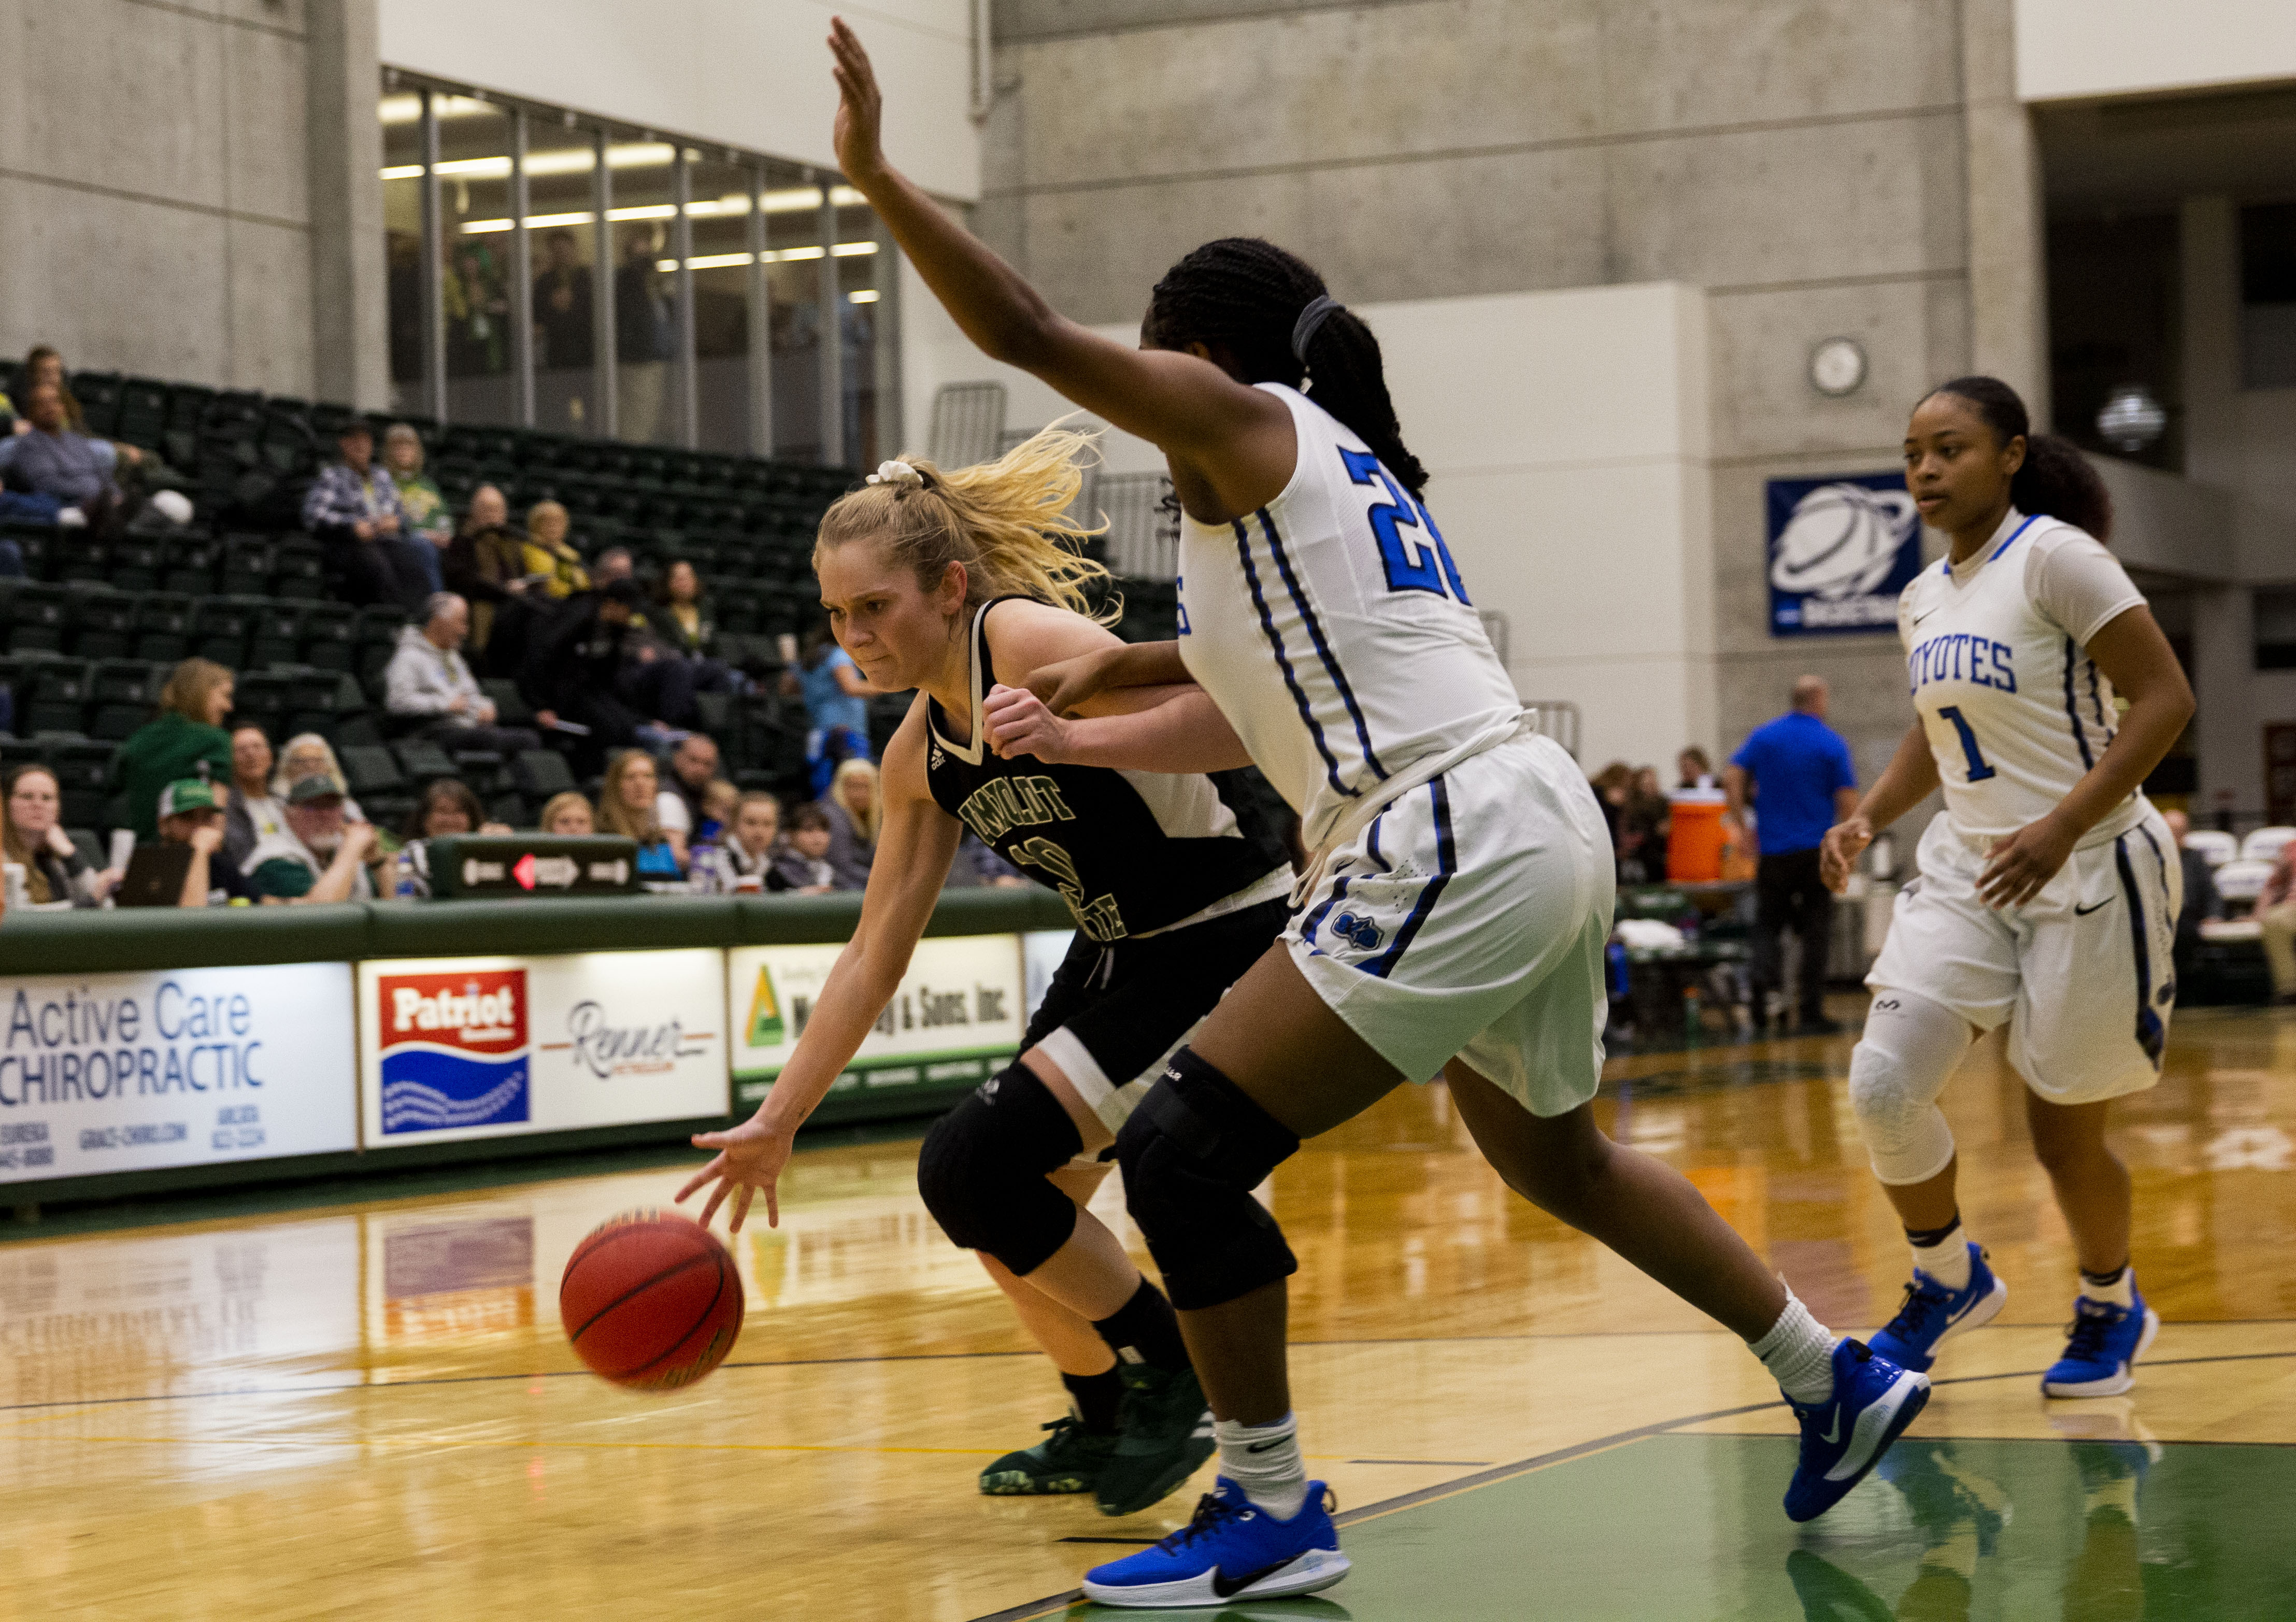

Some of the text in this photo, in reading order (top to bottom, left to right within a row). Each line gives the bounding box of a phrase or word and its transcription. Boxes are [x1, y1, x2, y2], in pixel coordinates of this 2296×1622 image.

[1335, 444, 1473, 607] 2
[1909, 633, 2017, 695] YOTES
[1937, 705, 1996, 783] 1
[6, 980, 252, 1048] Active Care
[392, 980, 516, 1032] Patriot
[0, 1040, 264, 1107] CHIROPRACTIC
